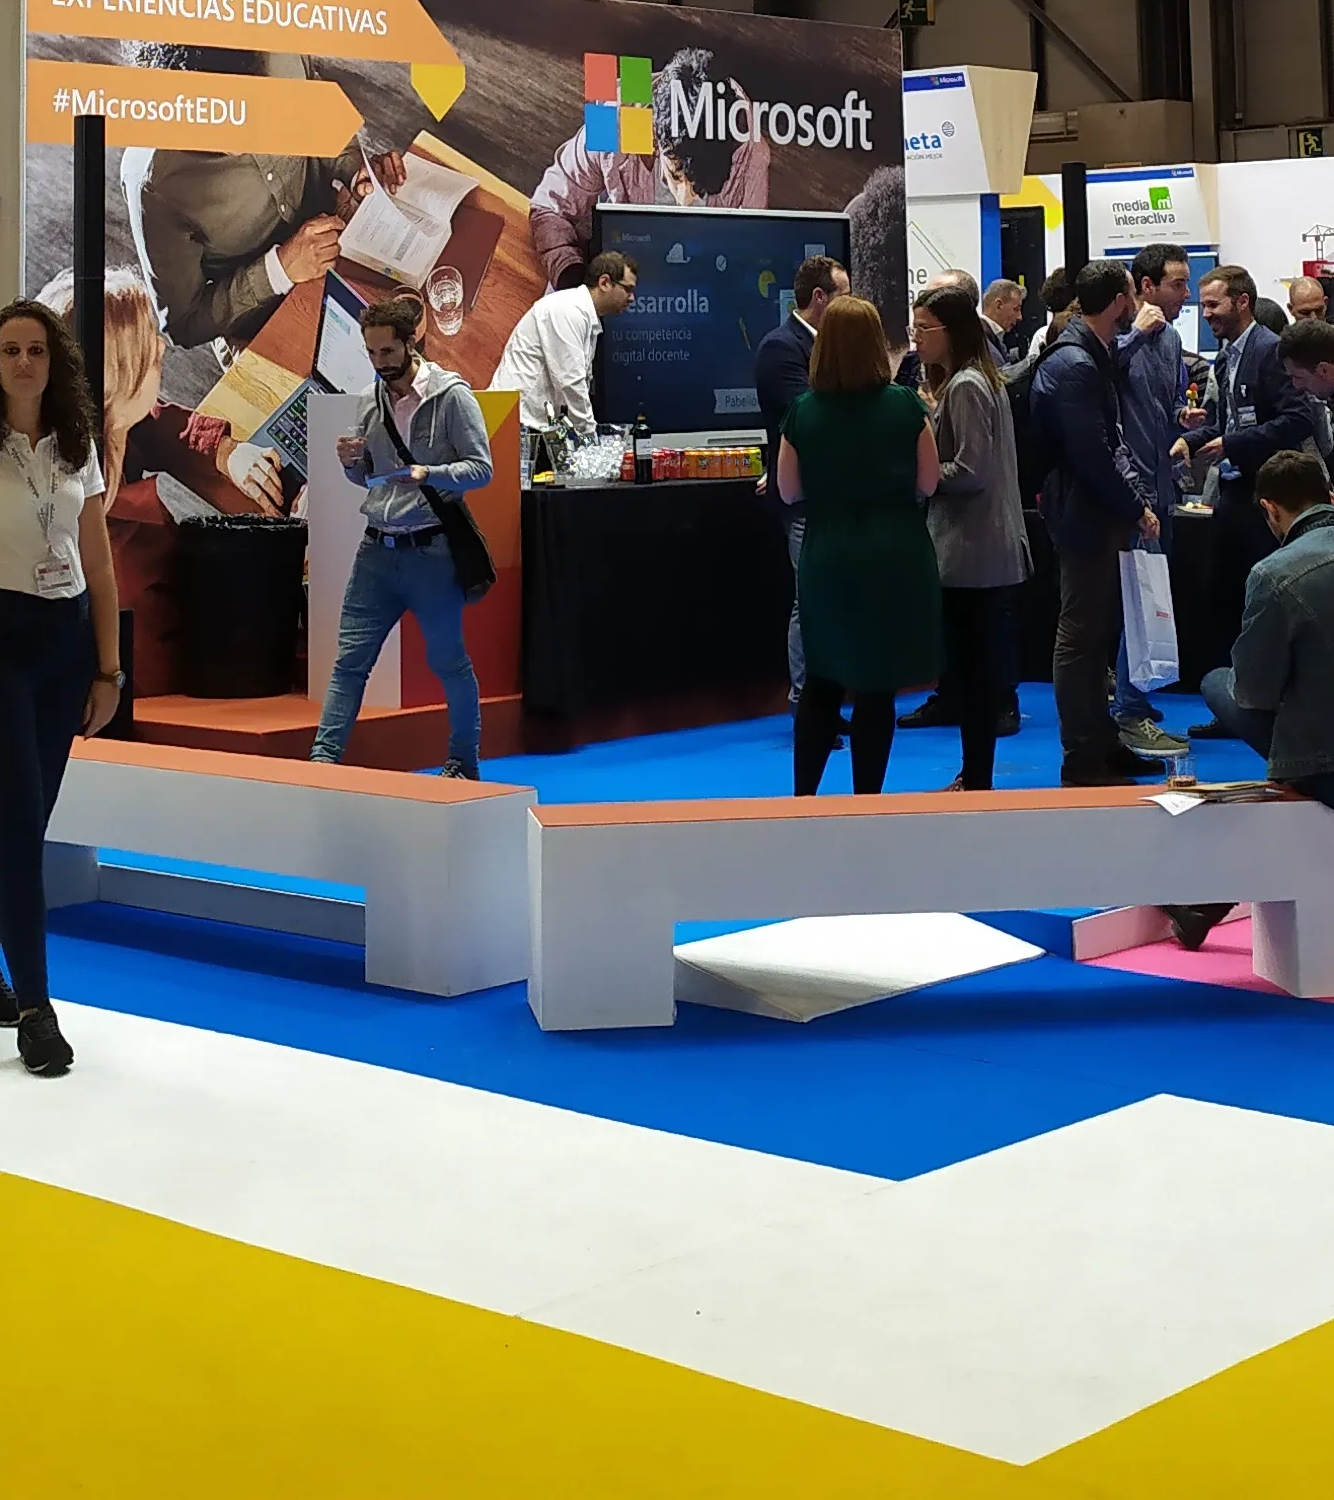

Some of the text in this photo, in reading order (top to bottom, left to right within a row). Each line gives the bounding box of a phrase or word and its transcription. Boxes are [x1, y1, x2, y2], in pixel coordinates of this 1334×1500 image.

[52, 87, 247, 127] #MicrosoftEDU
[670, 79, 873, 150] Microsoft
[1112, 200, 1149, 212] media
[1114, 213, 1175, 226] interactiva
[627, 289, 709, 313] esarrolla
[612, 328, 692, 344] tu competencia
[612, 348, 690, 366] digital docente
